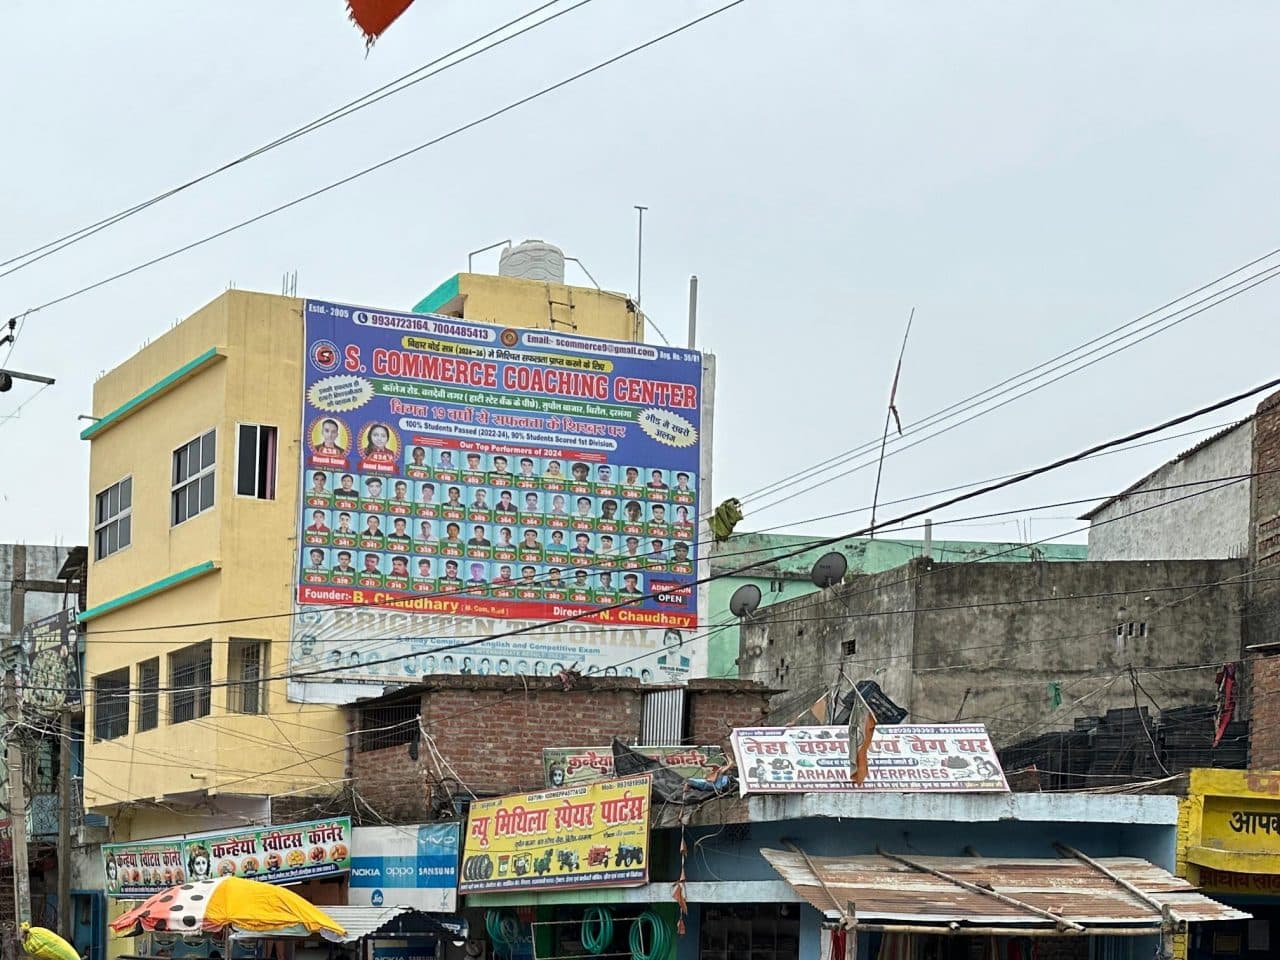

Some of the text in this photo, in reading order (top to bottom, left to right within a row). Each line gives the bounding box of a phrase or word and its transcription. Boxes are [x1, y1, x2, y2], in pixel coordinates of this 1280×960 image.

[433, 322, 489, 340] 7004485413
[345, 344, 697, 410] S. COMMERCE COACHING CENTER
[432, 406, 446, 420] 19
[424, 422, 453, 434] Students
[454, 425, 477, 436] Passed
[526, 432, 554, 444] Students
[459, 440, 562, 458] Our Top Performers of 2024
[304, 588, 352, 601] Founder:-
[352, 590, 369, 604] B.
[374, 593, 459, 614] Chaudhary
[658, 594, 682, 603] OPEN
[599, 610, 614, 621] N.
[618, 610, 691, 627] Chaudhary
[579, 645, 600, 654] Exam
[743, 737, 789, 756] नेहा
[954, 738, 990, 754] घर
[797, 768, 950, 781] ARHAM TERPRISES
[472, 816, 491, 849] न्यू
[495, 805, 550, 840] मिथिला
[555, 799, 596, 832] स्पेयर
[211, 821, 345, 859] कन्हैया स्वीटस कॉर्नर
[351, 868, 381, 877] NOKIA
[386, 866, 414, 878] oppo
[418, 866, 455, 876] SAMSUNG
[373, 893, 383, 903] Jio
